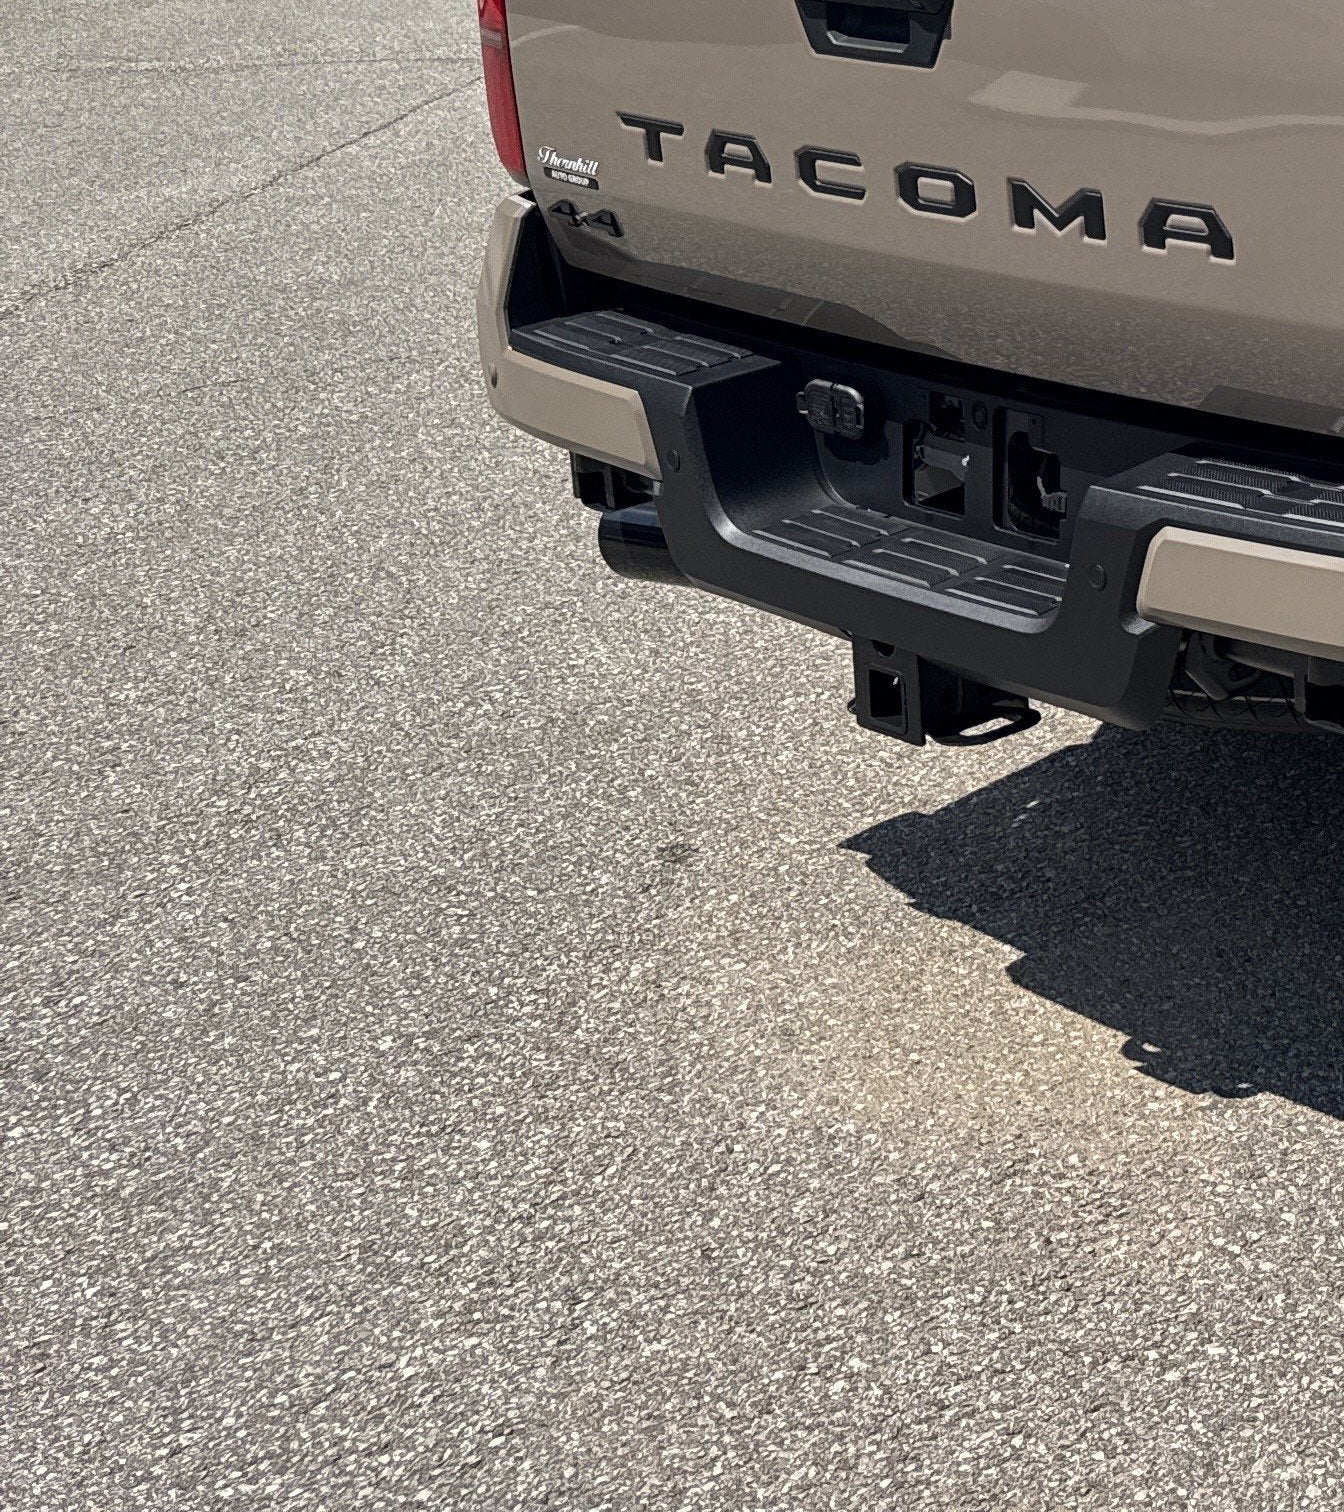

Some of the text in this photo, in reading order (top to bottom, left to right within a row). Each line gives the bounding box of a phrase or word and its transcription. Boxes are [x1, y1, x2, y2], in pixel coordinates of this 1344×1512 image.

[536, 145, 600, 176] Thornhill
[551, 169, 590, 187] AUTO GROUP
[615, 110, 1236, 262] TACOMA
